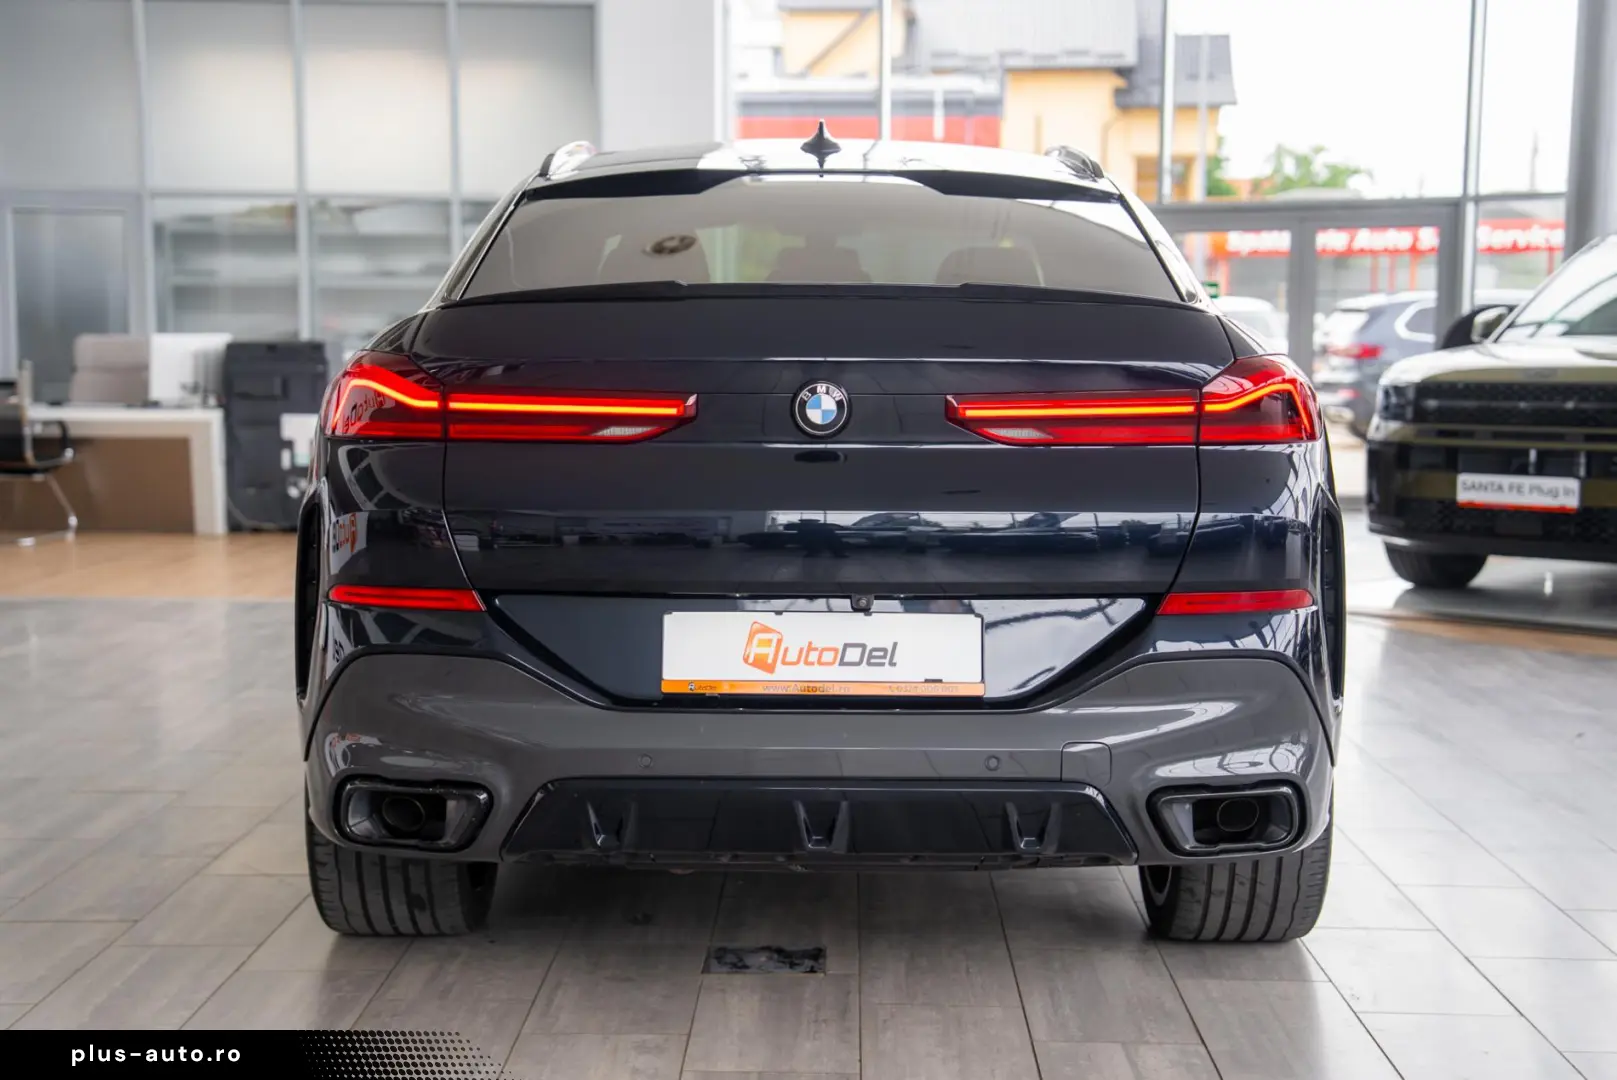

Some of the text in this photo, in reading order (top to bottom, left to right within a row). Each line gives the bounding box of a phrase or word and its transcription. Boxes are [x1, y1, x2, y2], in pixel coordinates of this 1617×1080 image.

[801, 385, 842, 401] BMW
[1462, 480, 1504, 493] SANTA
[1509, 482, 1525, 496] FE
[1528, 483, 1559, 499] Plug
[745, 630, 898, 668] AutoDel
